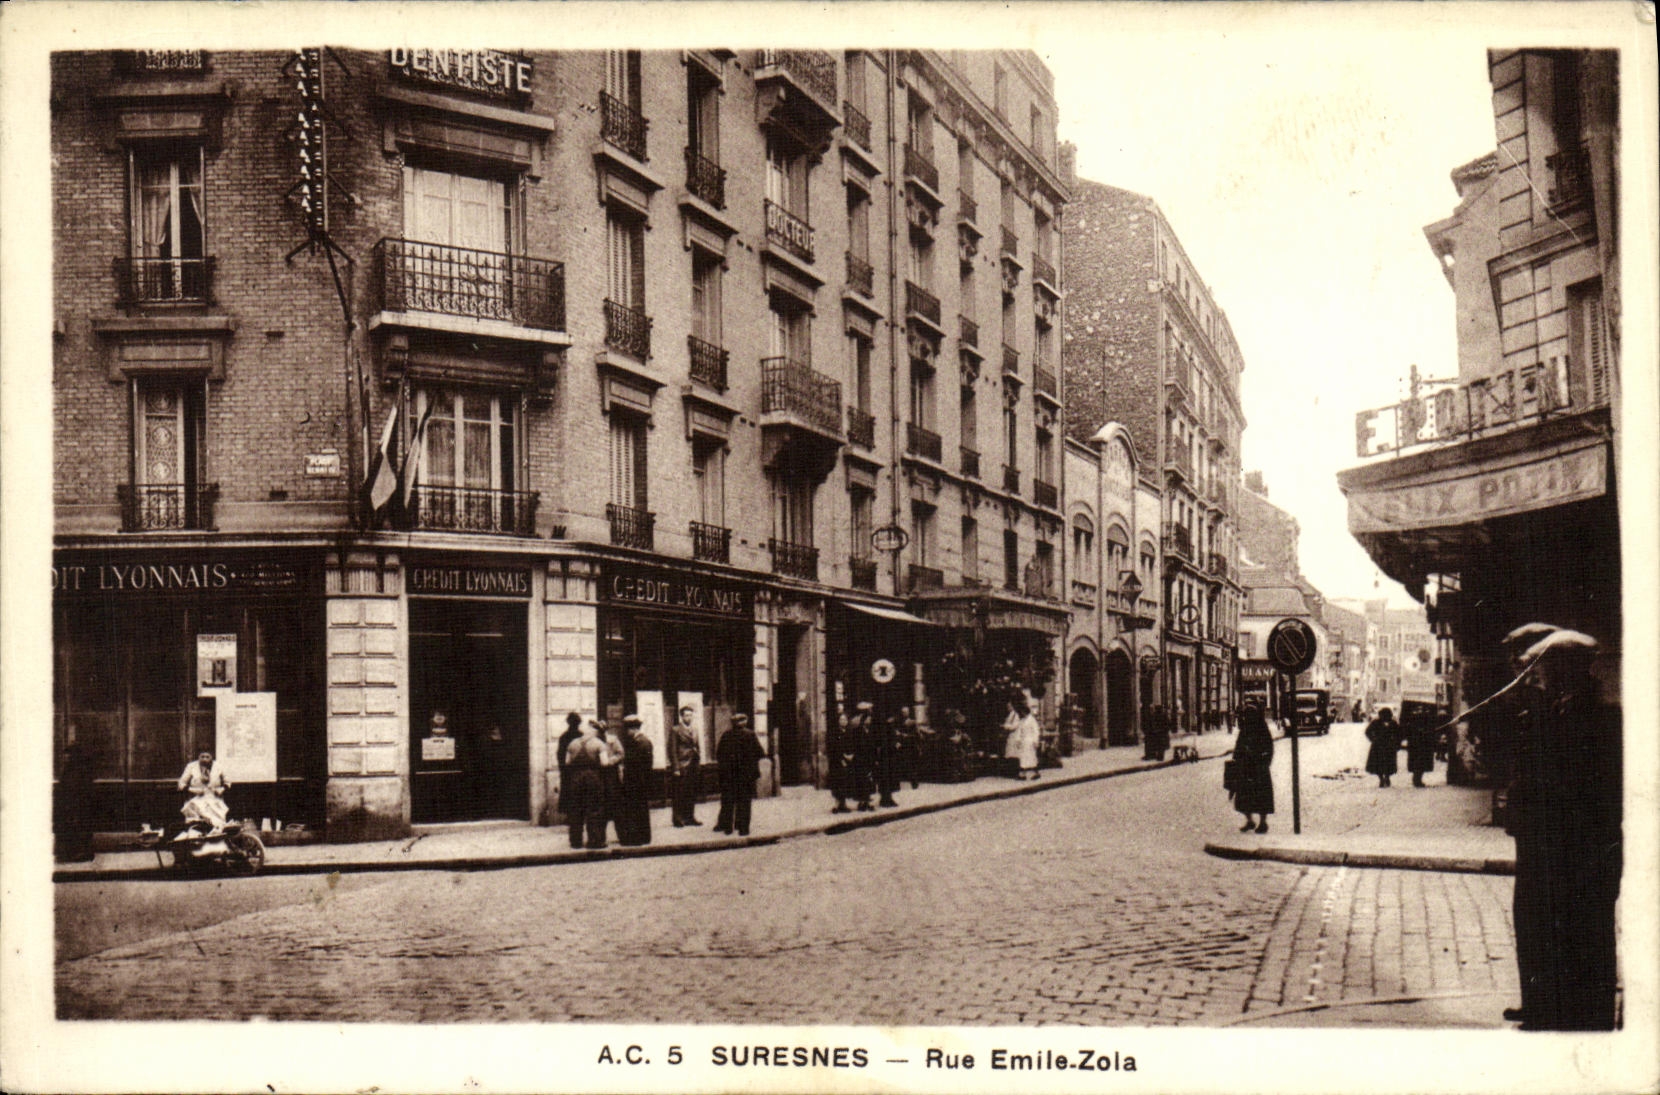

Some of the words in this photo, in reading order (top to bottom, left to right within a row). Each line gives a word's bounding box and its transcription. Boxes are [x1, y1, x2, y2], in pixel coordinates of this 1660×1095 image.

[390, 48, 532, 93] DENTISTE
[100, 563, 228, 590] LYONNAIS
[466, 570, 528, 593] LYONNAIS
[677, 583, 743, 613] LYONAIS
